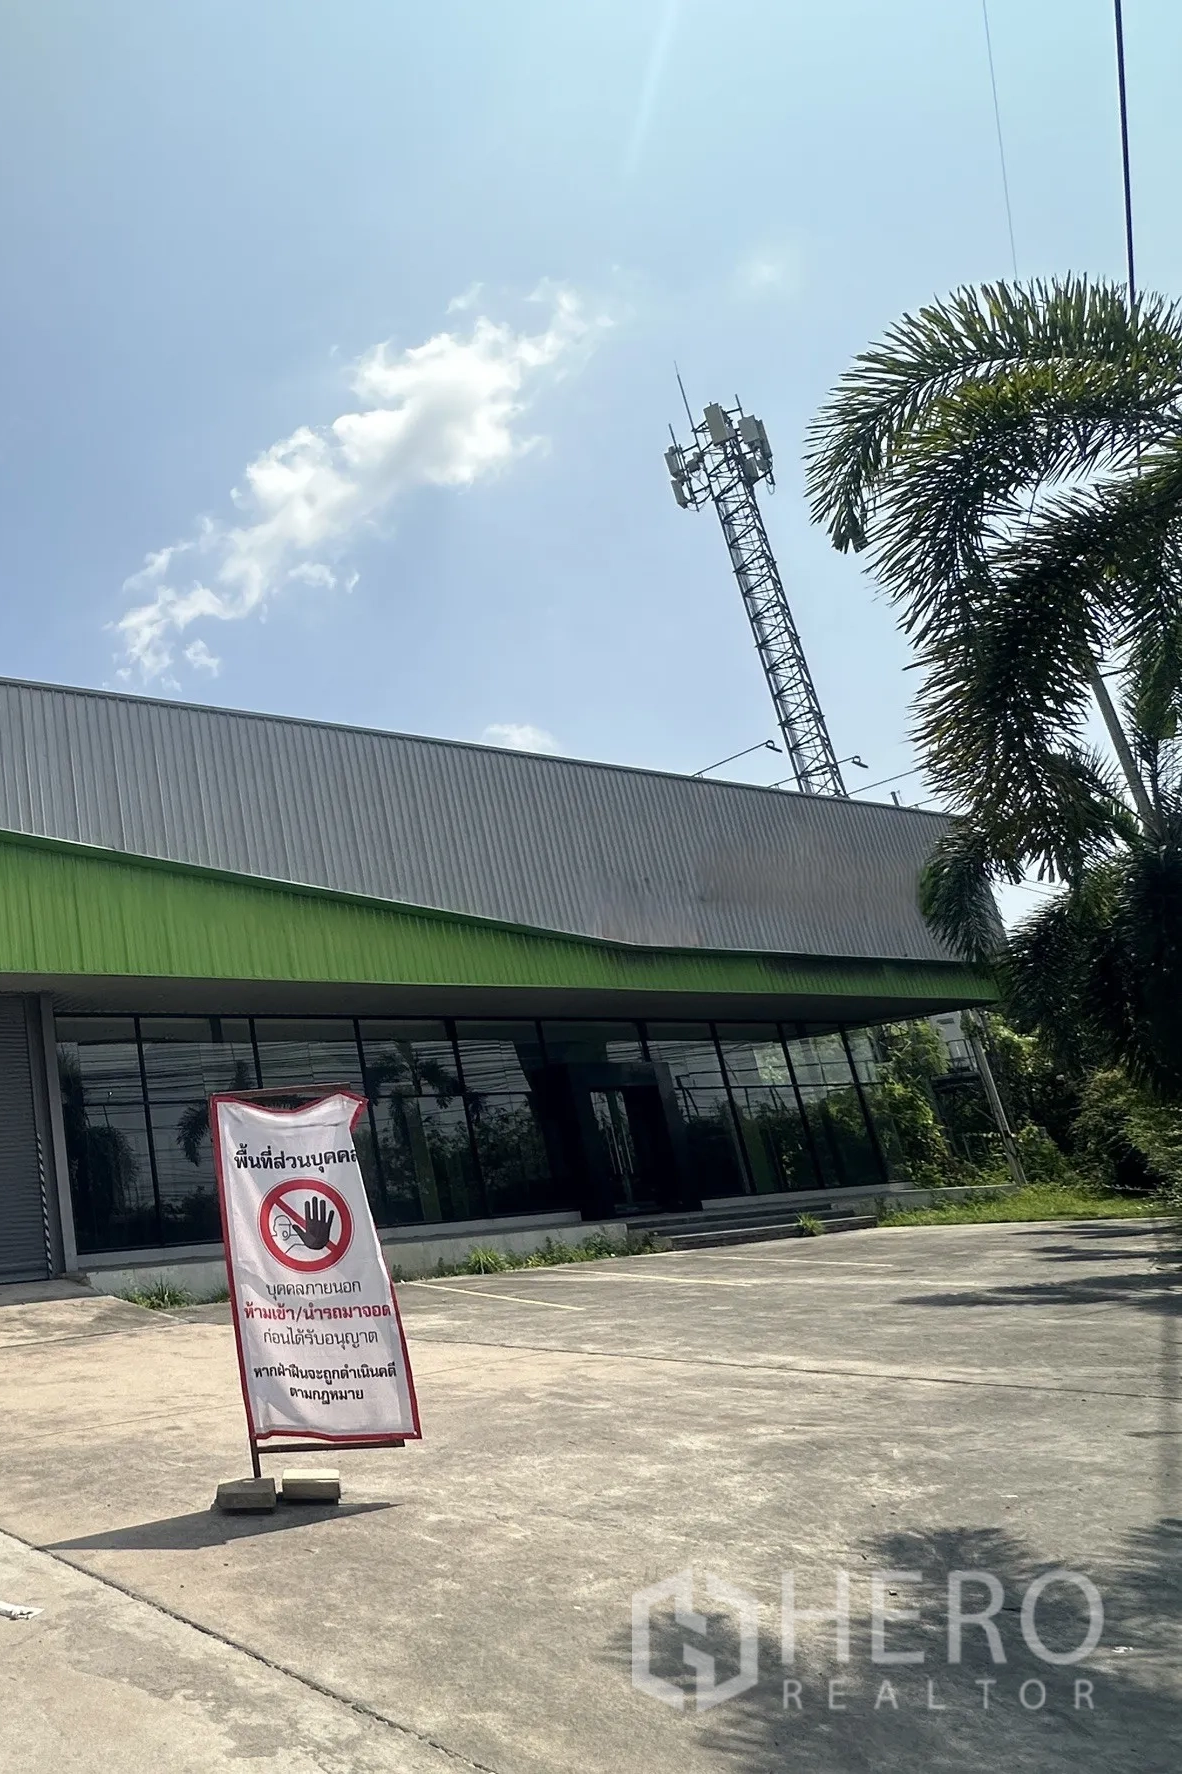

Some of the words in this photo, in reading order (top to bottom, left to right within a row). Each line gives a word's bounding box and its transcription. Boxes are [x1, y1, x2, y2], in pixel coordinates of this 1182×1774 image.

[266, 1279, 362, 1301] บุคคลภายนอก
[244, 1301, 392, 1322] ห้ามเข้า/นำรถมาจอด
[263, 1326, 379, 1349] ก่อนได้รับอนุญาต
[253, 1361, 397, 1385] หากฝ่าฝืนจะถูกดำเนินคดี
[289, 1387, 364, 1405] ตามกฎหมาย
